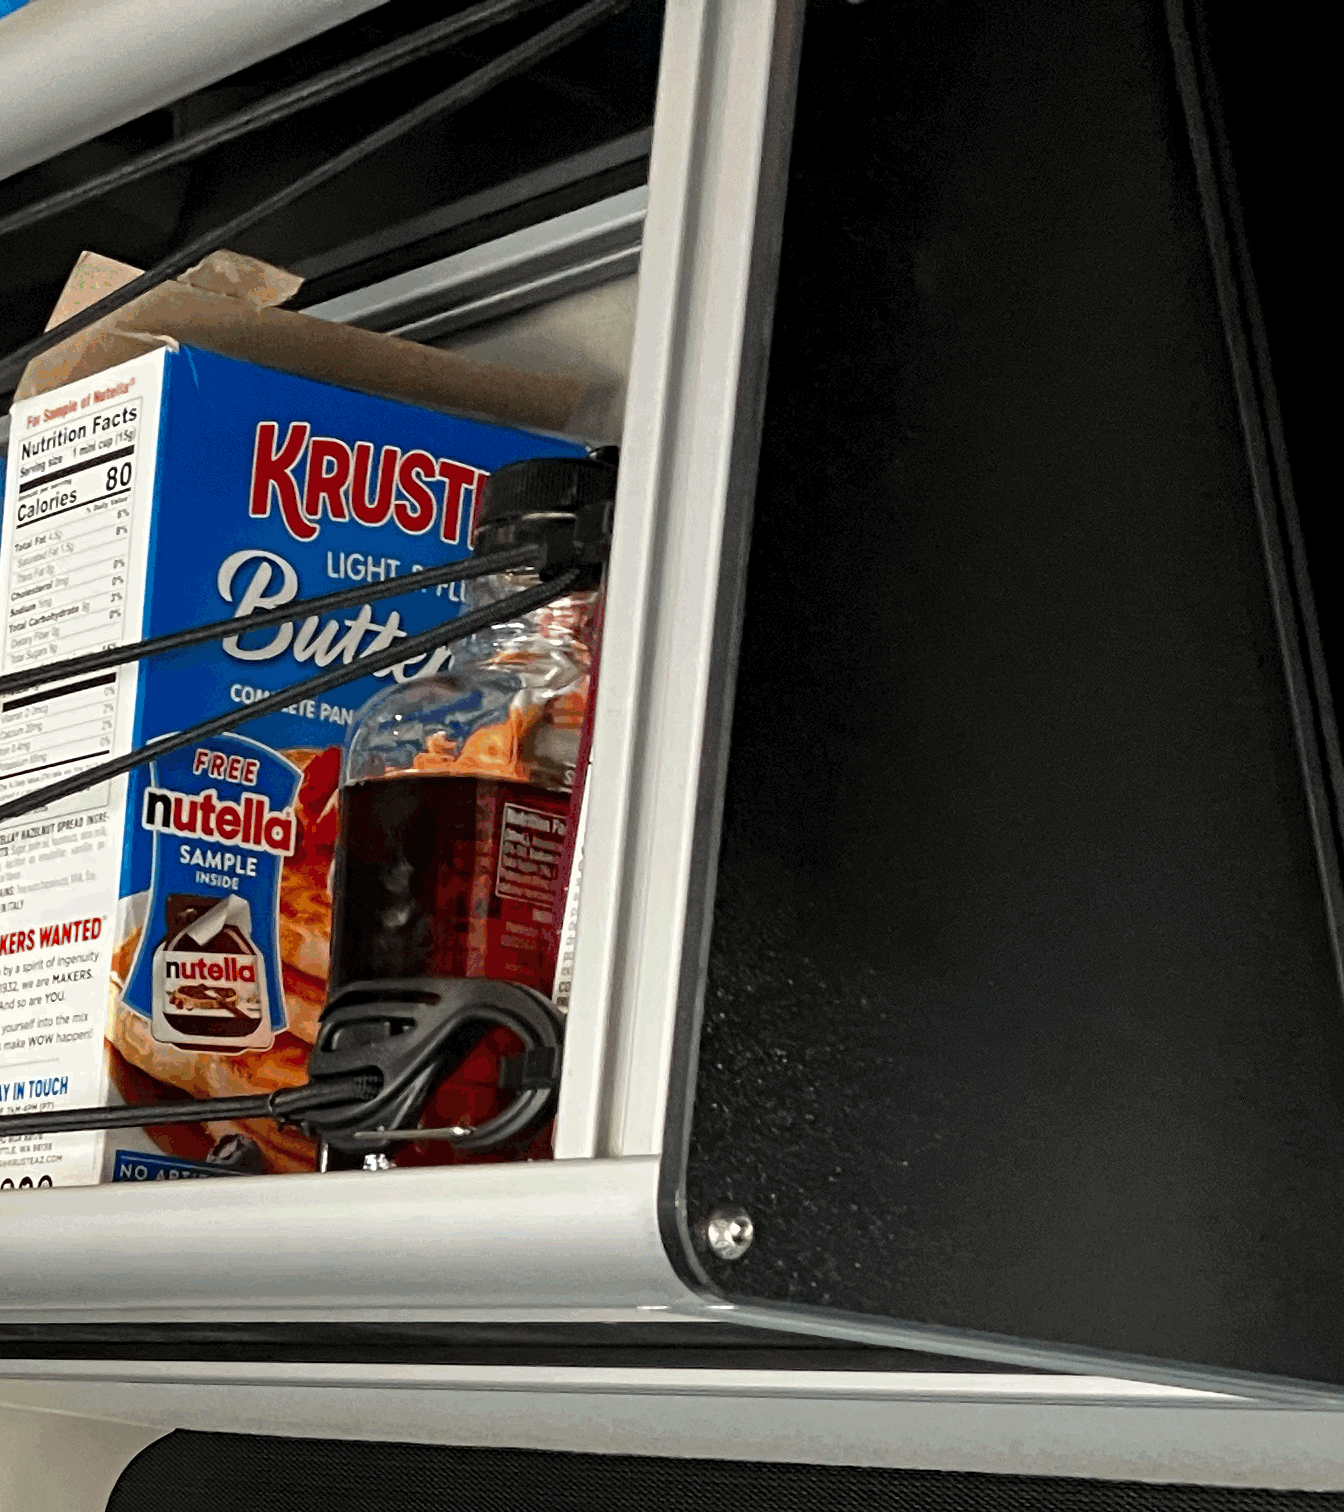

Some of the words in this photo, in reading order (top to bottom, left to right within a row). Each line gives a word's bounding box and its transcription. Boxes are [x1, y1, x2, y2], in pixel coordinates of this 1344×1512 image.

[22, 426, 86, 460] Nutrition
[92, 408, 137, 434] Facts
[17, 490, 77, 521] Calories
[106, 461, 132, 491] 80
[327, 550, 401, 582] LIGHT
[319, 703, 353, 725] PAN
[193, 748, 260, 786] FREE
[145, 790, 295, 855] nutella
[180, 845, 258, 877] SAMPLE
[195, 870, 240, 890] INSIDE
[3, 965, 13, 977] by
[22, 959, 44, 973] spirit
[45, 956, 56, 968] of
[57, 951, 100, 967] ingenuity
[166, 957, 255, 983] nutella
[22, 980, 33, 989] we
[36, 978, 50, 988] are
[17, 998, 26, 1009] so
[28, 996, 42, 1006] are
[1, 1018, 35, 1036] yourself
[37, 1018, 53, 1028] into
[55, 1015, 70, 1025] the
[71, 1013, 88, 1024] mix
[3, 1039, 26, 1051] make
[28, 1033, 54, 1047] WOW
[13, 1081, 25, 1101] IN
[28, 1075, 69, 1099] TOUCH
[119, 1164, 148, 1180] NO
